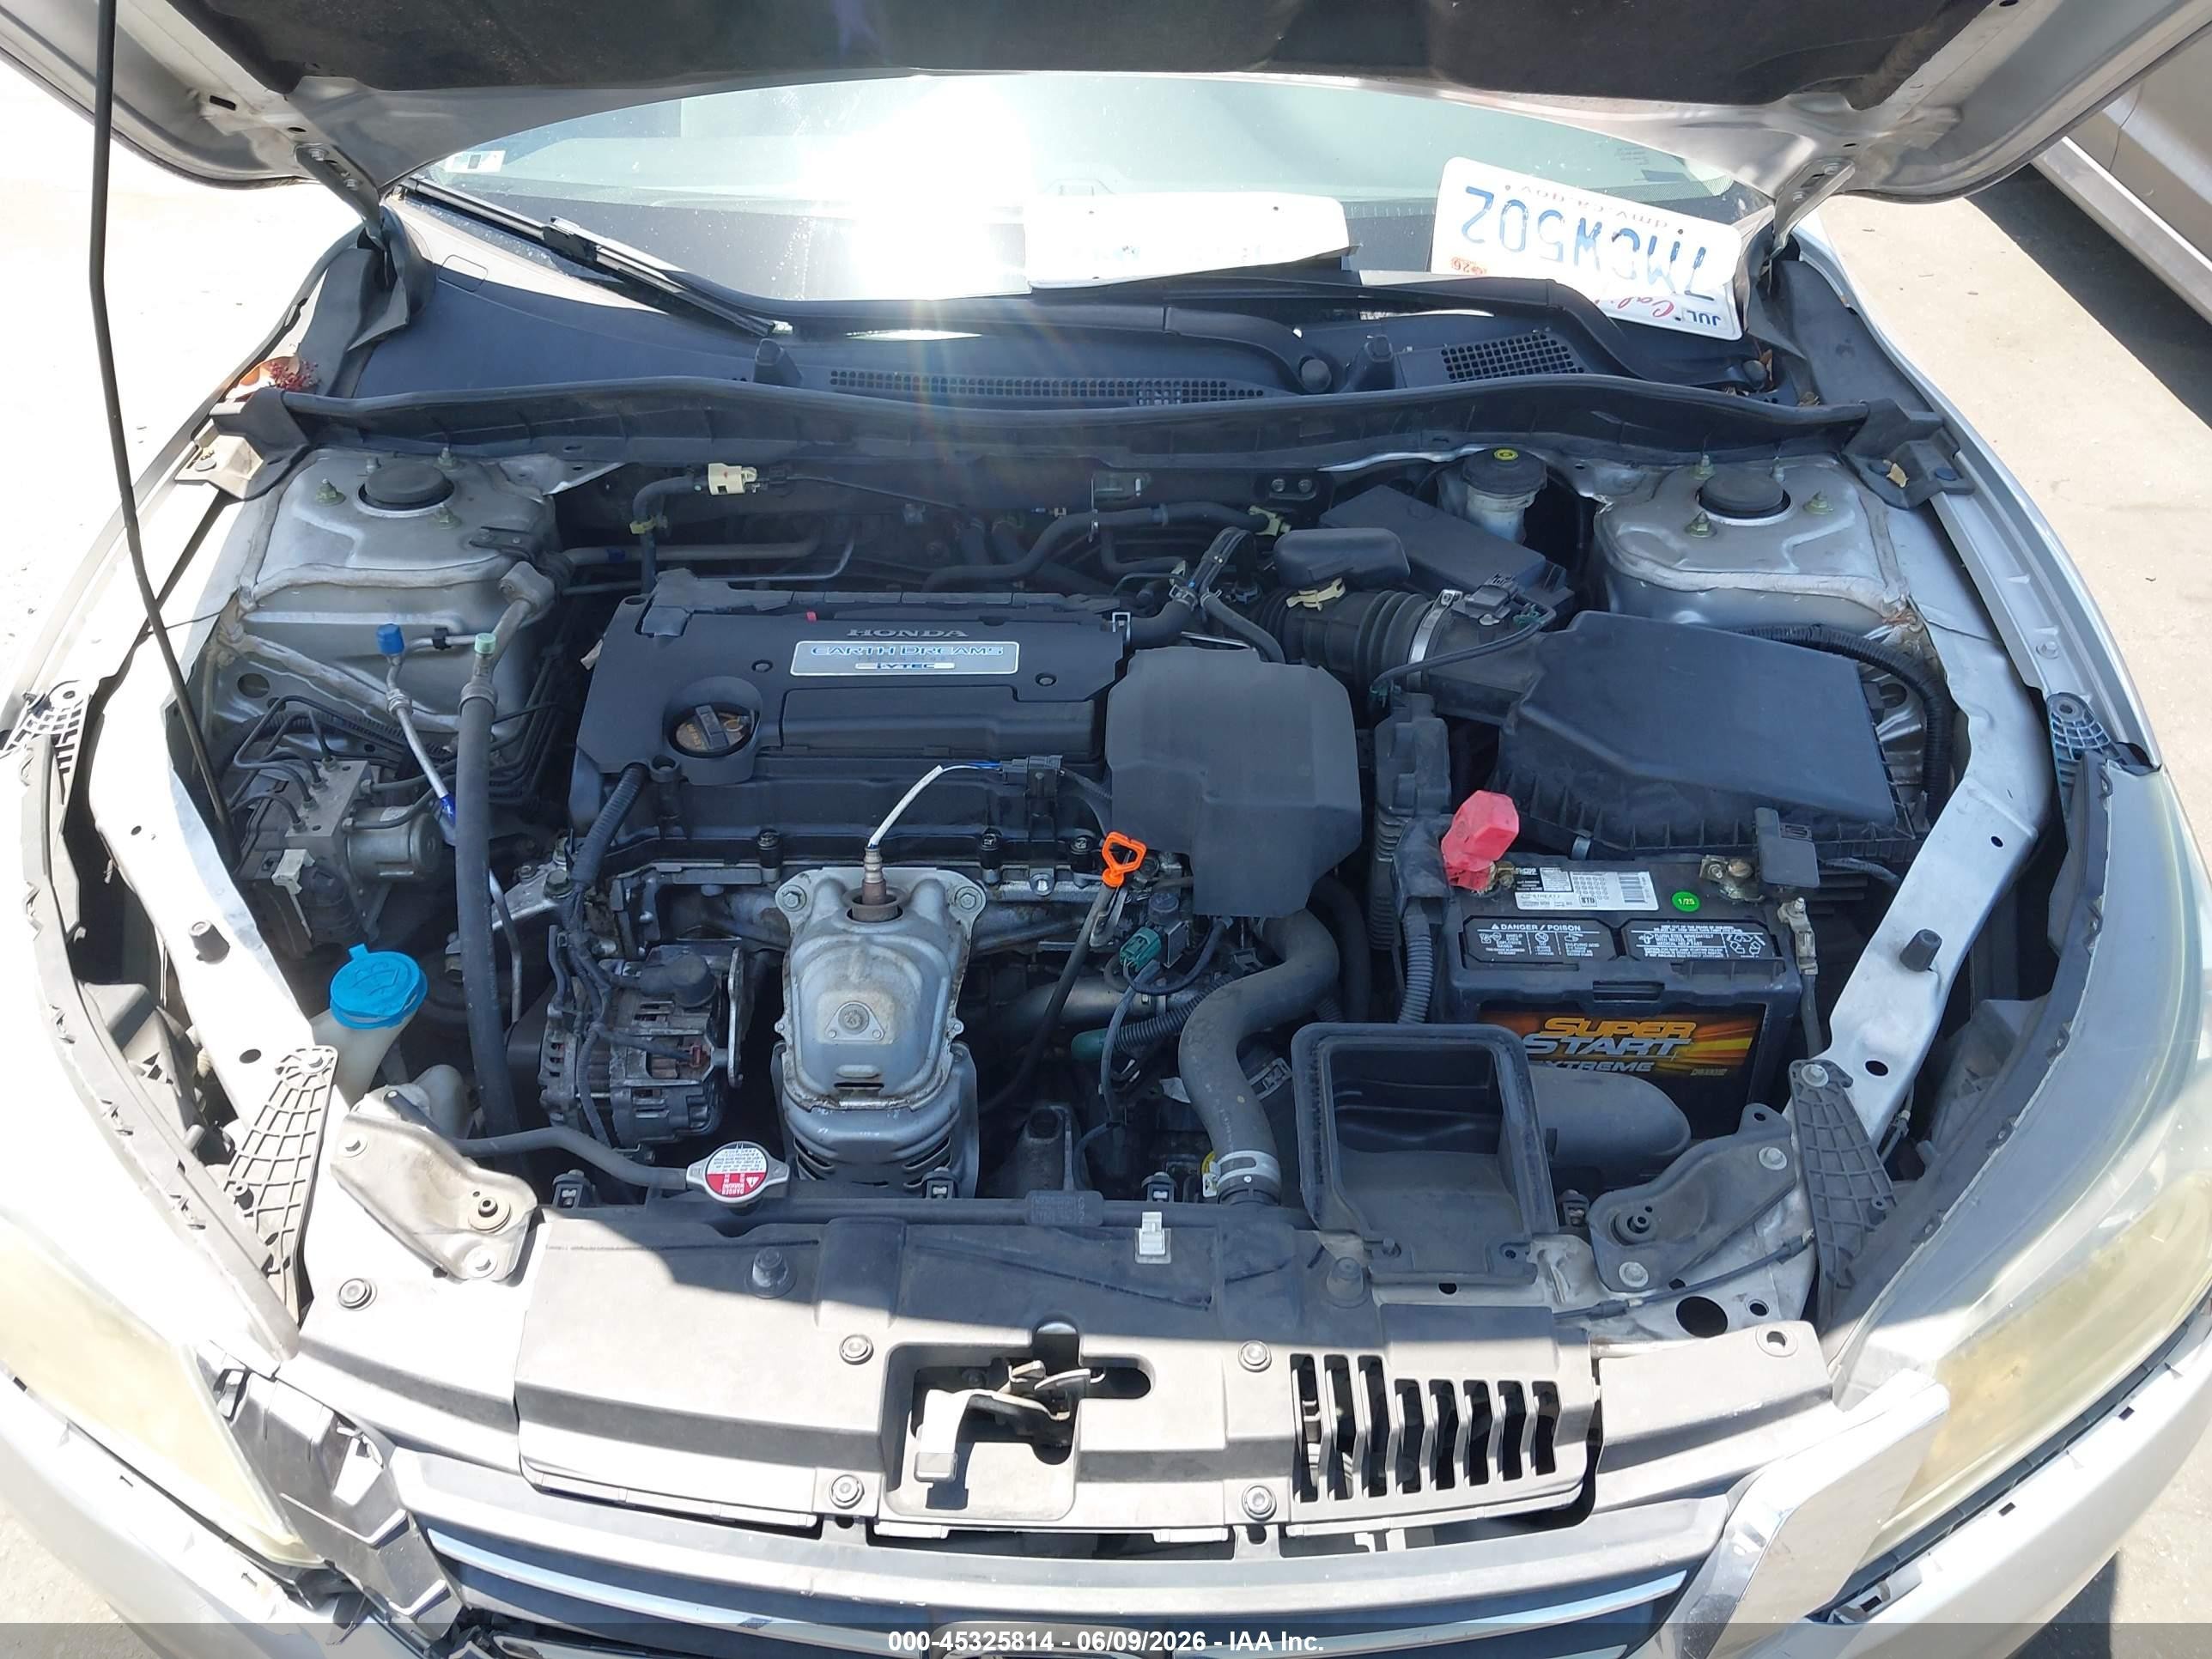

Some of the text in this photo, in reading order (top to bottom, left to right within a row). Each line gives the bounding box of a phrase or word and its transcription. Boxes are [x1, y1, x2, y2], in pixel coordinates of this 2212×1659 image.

[1461, 185, 1715, 301] 7MCW502
[1687, 310, 1722, 326] JUL
[847, 629, 969, 638] HONDA
[811, 646, 1004, 656] EARTH DREAMS
[1538, 1017, 1697, 1038] SUPER
[1522, 1033, 1692, 1055] START
[1532, 1060, 1655, 1073] XTREME
